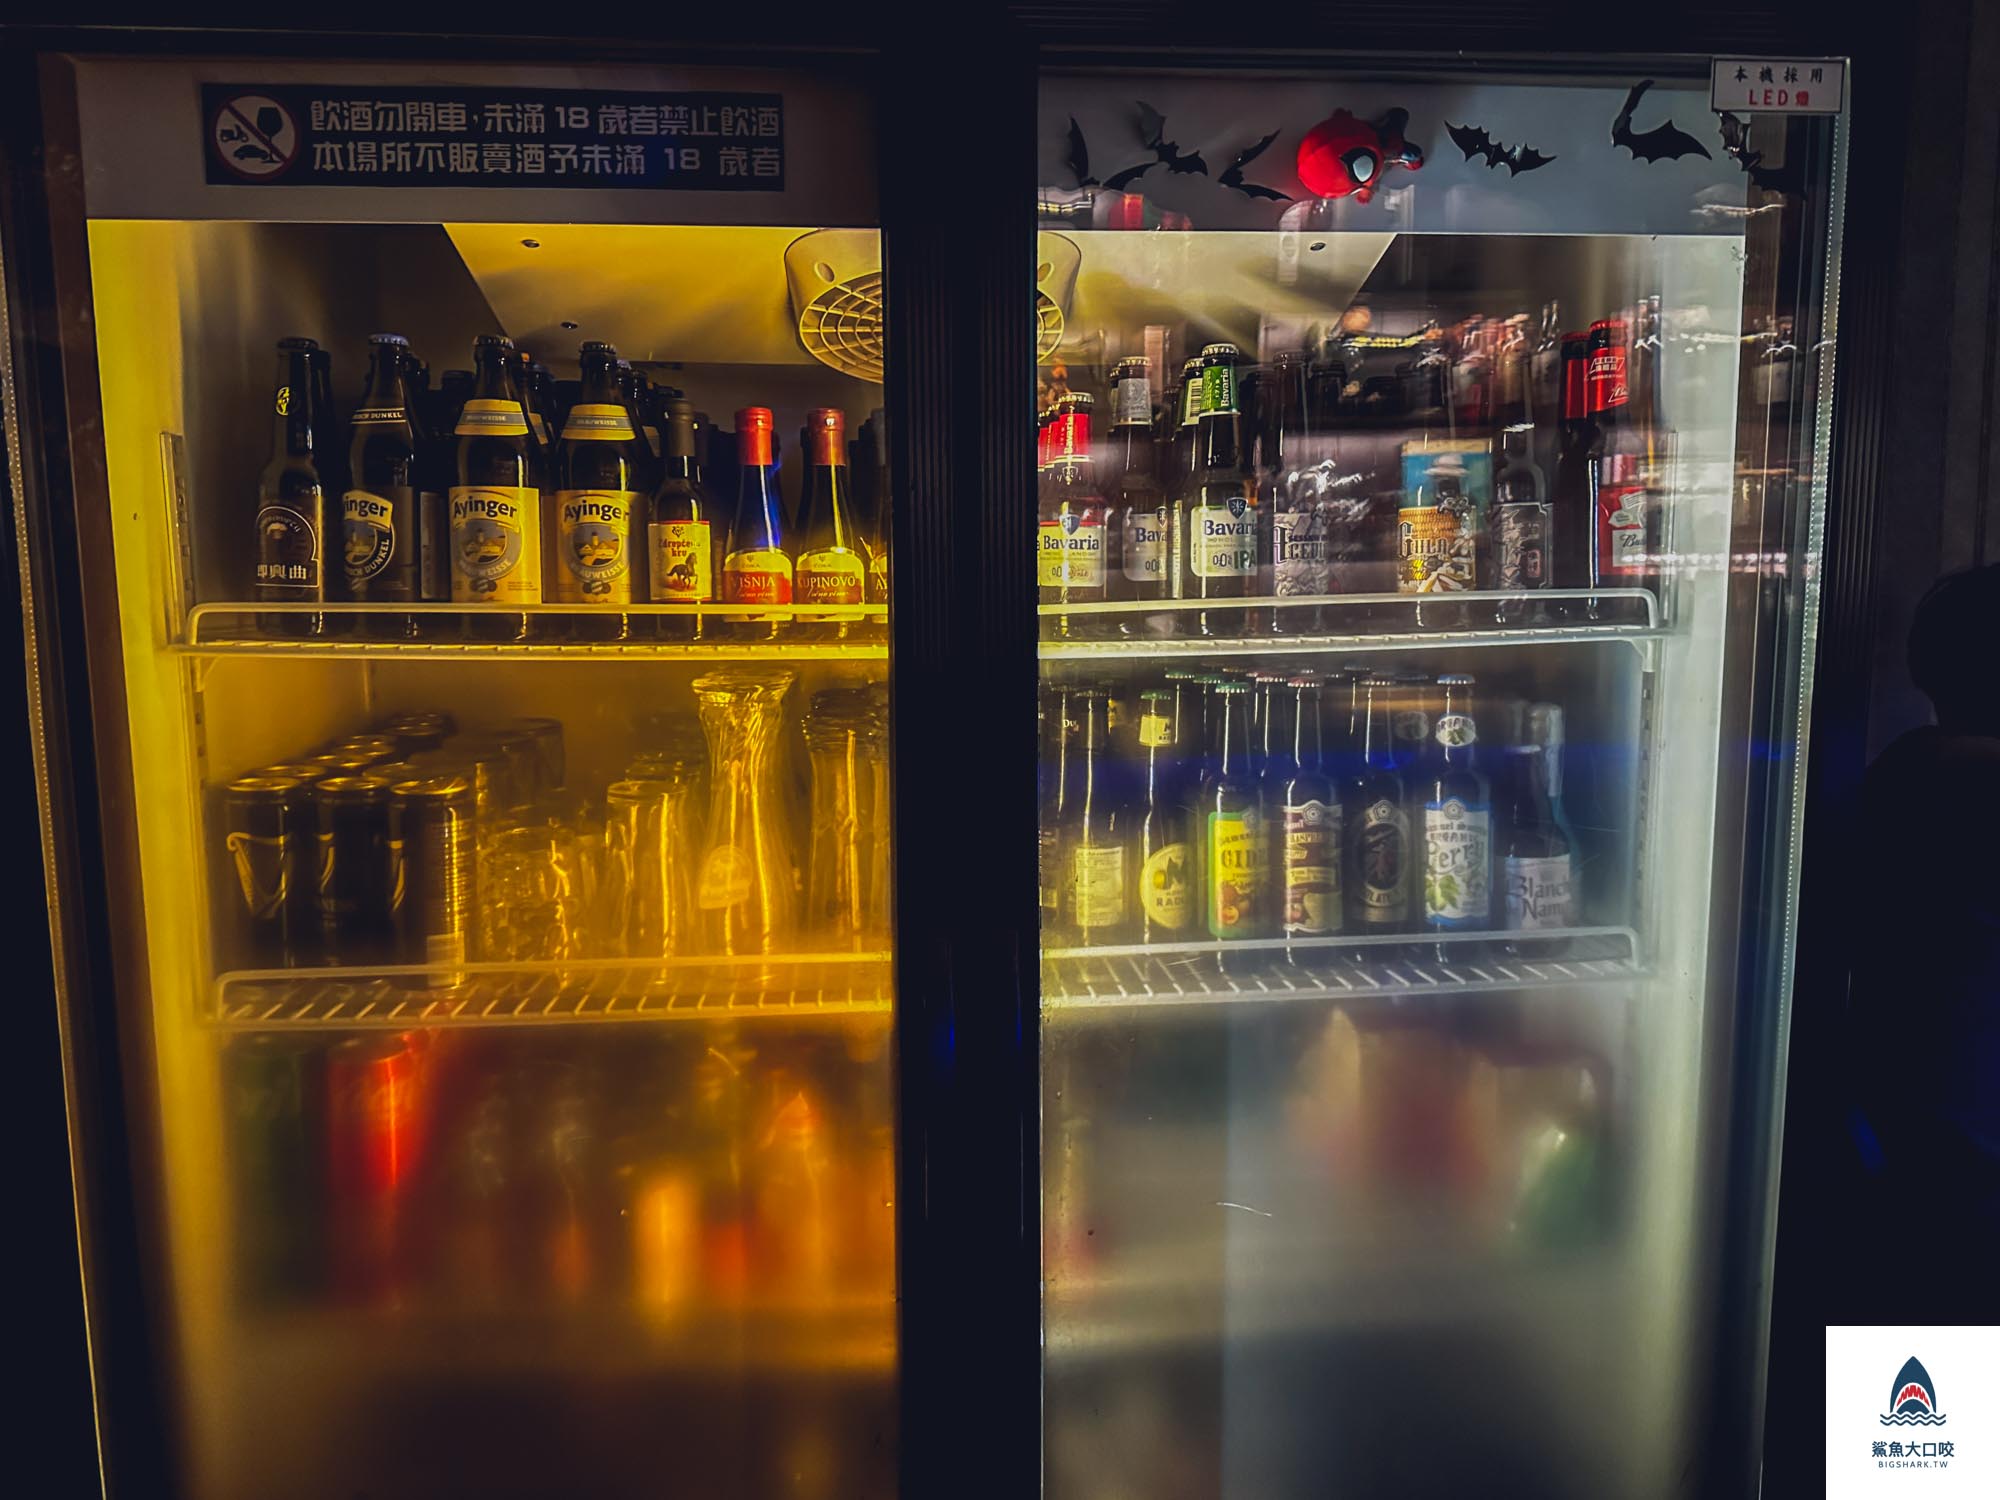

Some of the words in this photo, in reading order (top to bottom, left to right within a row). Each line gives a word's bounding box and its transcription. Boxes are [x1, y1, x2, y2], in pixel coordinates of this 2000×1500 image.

[1734, 65, 1823, 84] 本機採用
[556, 106, 590, 129] 18
[598, 105, 780, 137] 歲者禁止飲酒
[312, 141, 647, 176] 本場所不販賣酒予未滿
[663, 148, 702, 170] 18
[719, 146, 781, 177] 歲者
[1220, 367, 1230, 407] Bavaria
[370, 411, 403, 420] DUNKEL
[453, 496, 518, 519] Ayinger
[564, 496, 630, 524] Ayinger
[364, 538, 390, 575] DUNKEL
[1043, 535, 1100, 551] Bavaria
